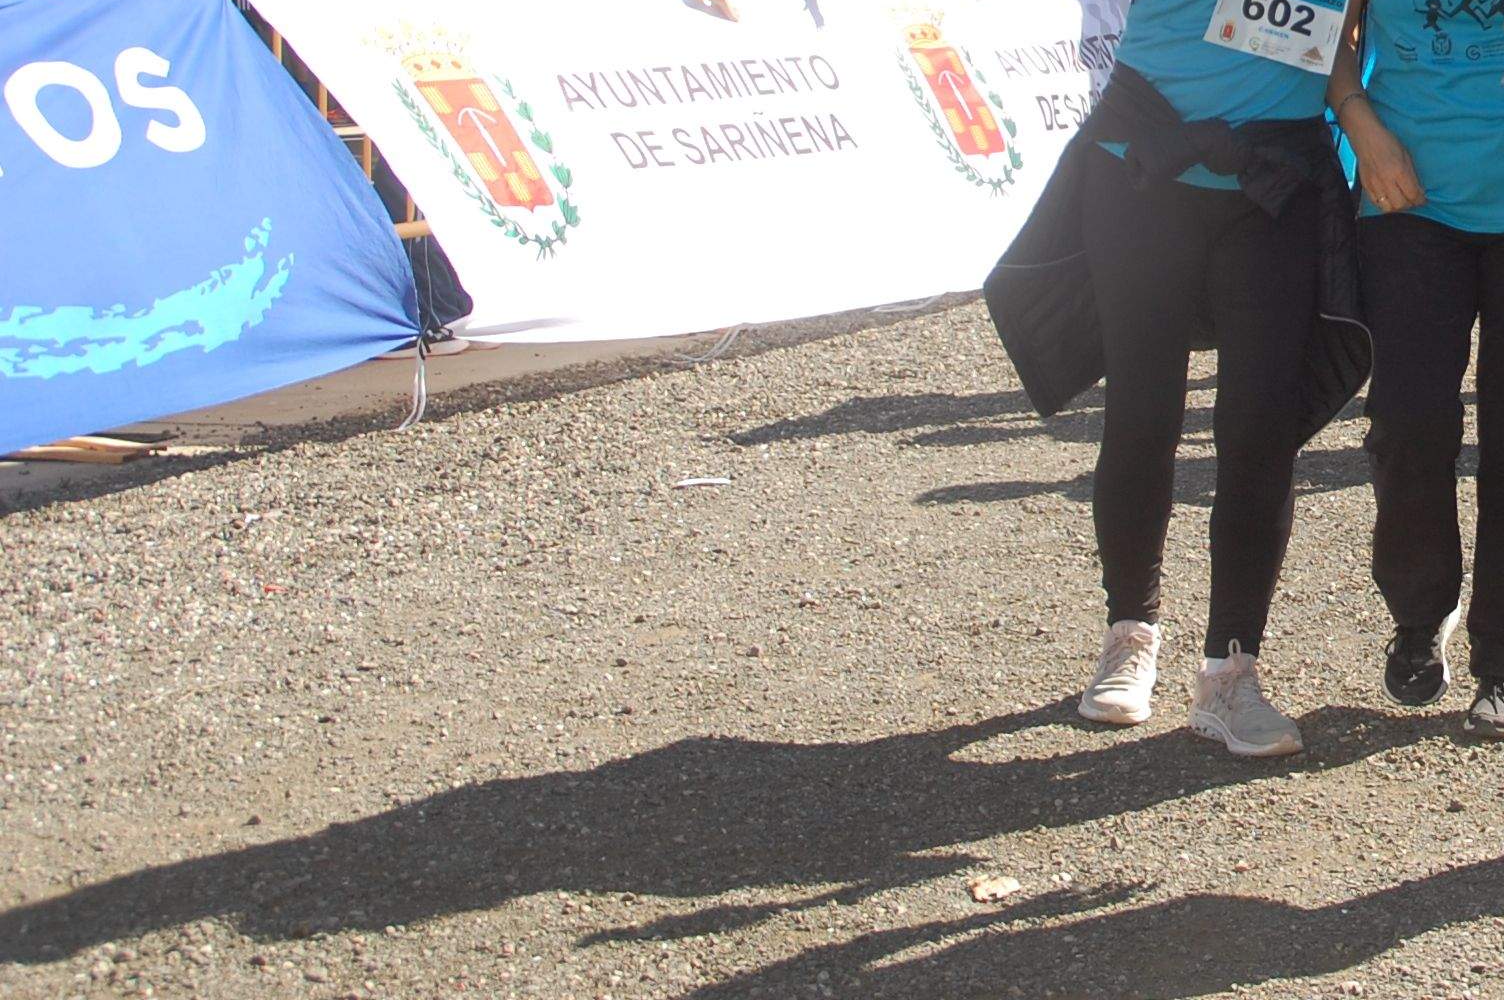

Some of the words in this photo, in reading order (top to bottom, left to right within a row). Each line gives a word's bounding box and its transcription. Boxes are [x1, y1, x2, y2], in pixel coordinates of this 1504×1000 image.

[0, 46, 206, 168] OS
[556, 55, 840, 112] AYUNTAMIENTO
[1035, 94, 1069, 131] DE
[611, 129, 667, 170] DE
[683, 111, 859, 166] SARIÑENA
